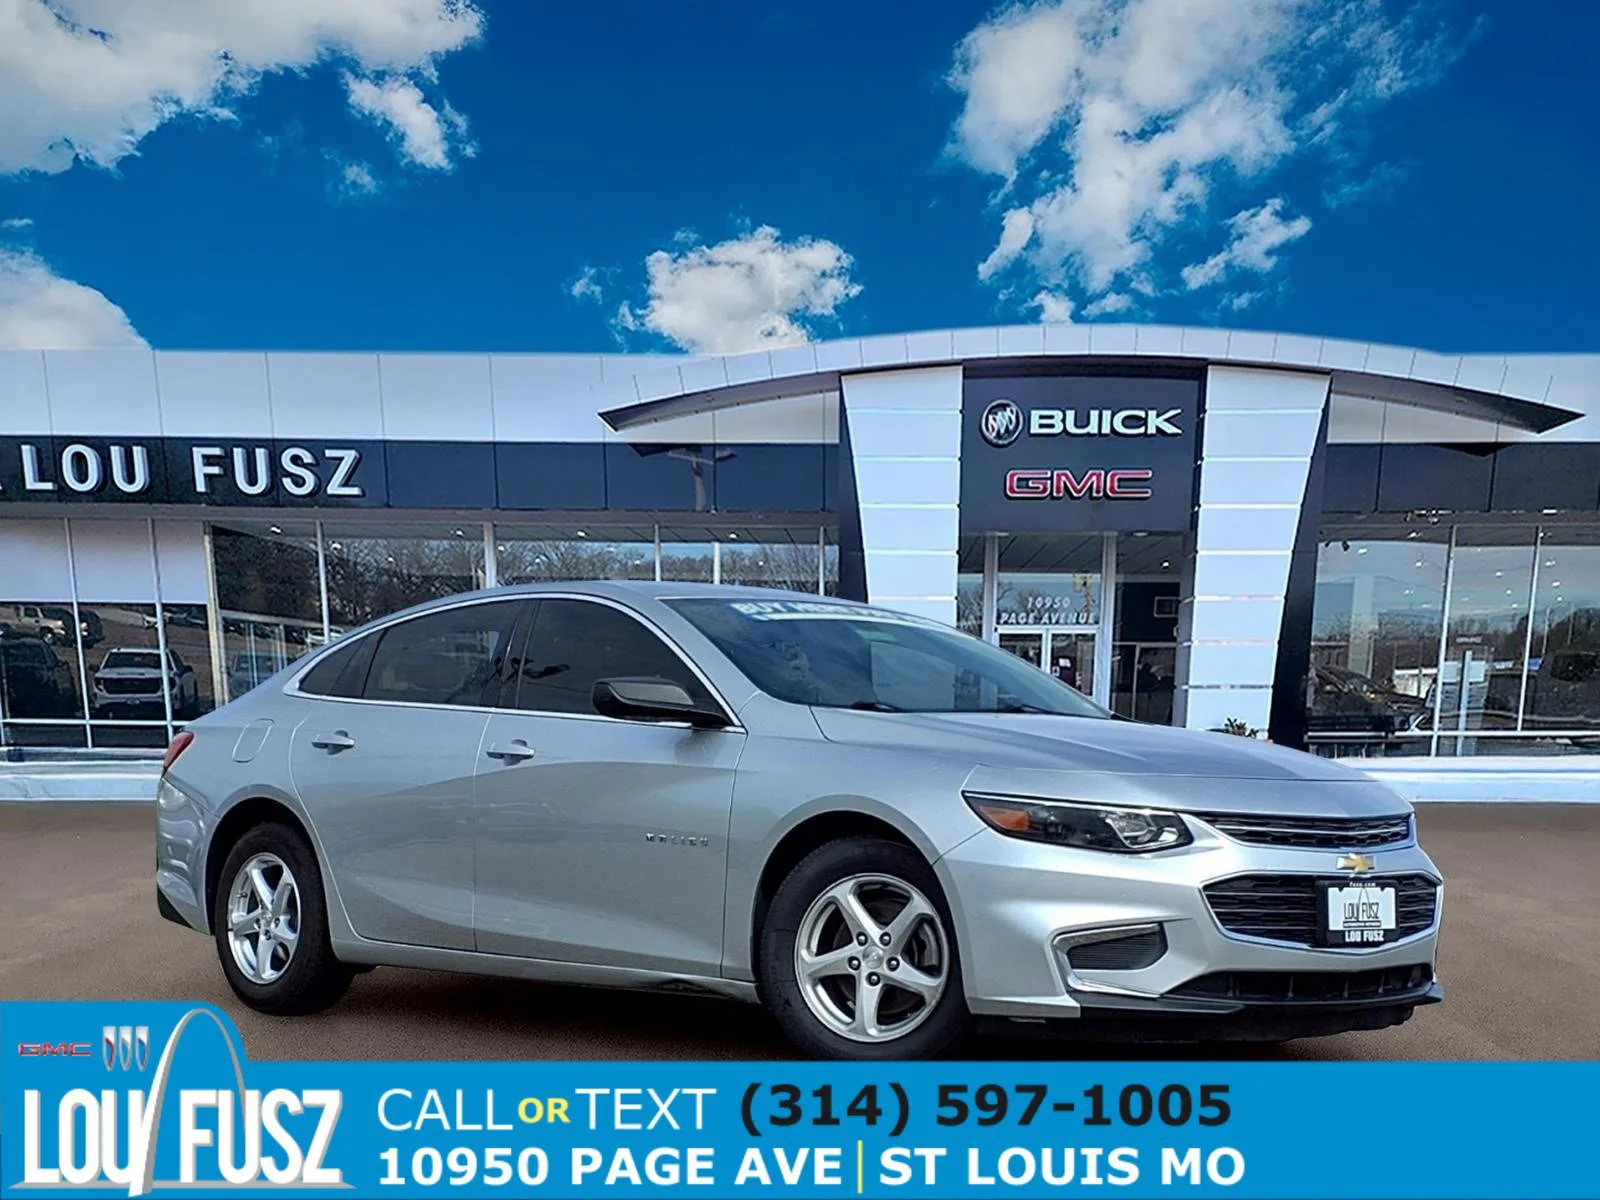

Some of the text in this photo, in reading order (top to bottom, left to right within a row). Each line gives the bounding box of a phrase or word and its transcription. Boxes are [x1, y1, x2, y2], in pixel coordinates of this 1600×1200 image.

[1029, 408, 1183, 436] BUICK
[20, 443, 365, 497] LOU FUSZ
[1006, 469, 1152, 498] GMC
[1027, 596, 1072, 609] 10950
[1000, 611, 1095, 624] PAGE AVENUE
[1344, 902, 1380, 920] LOU FUSZ
[1345, 930, 1384, 942] LOU FUSZ
